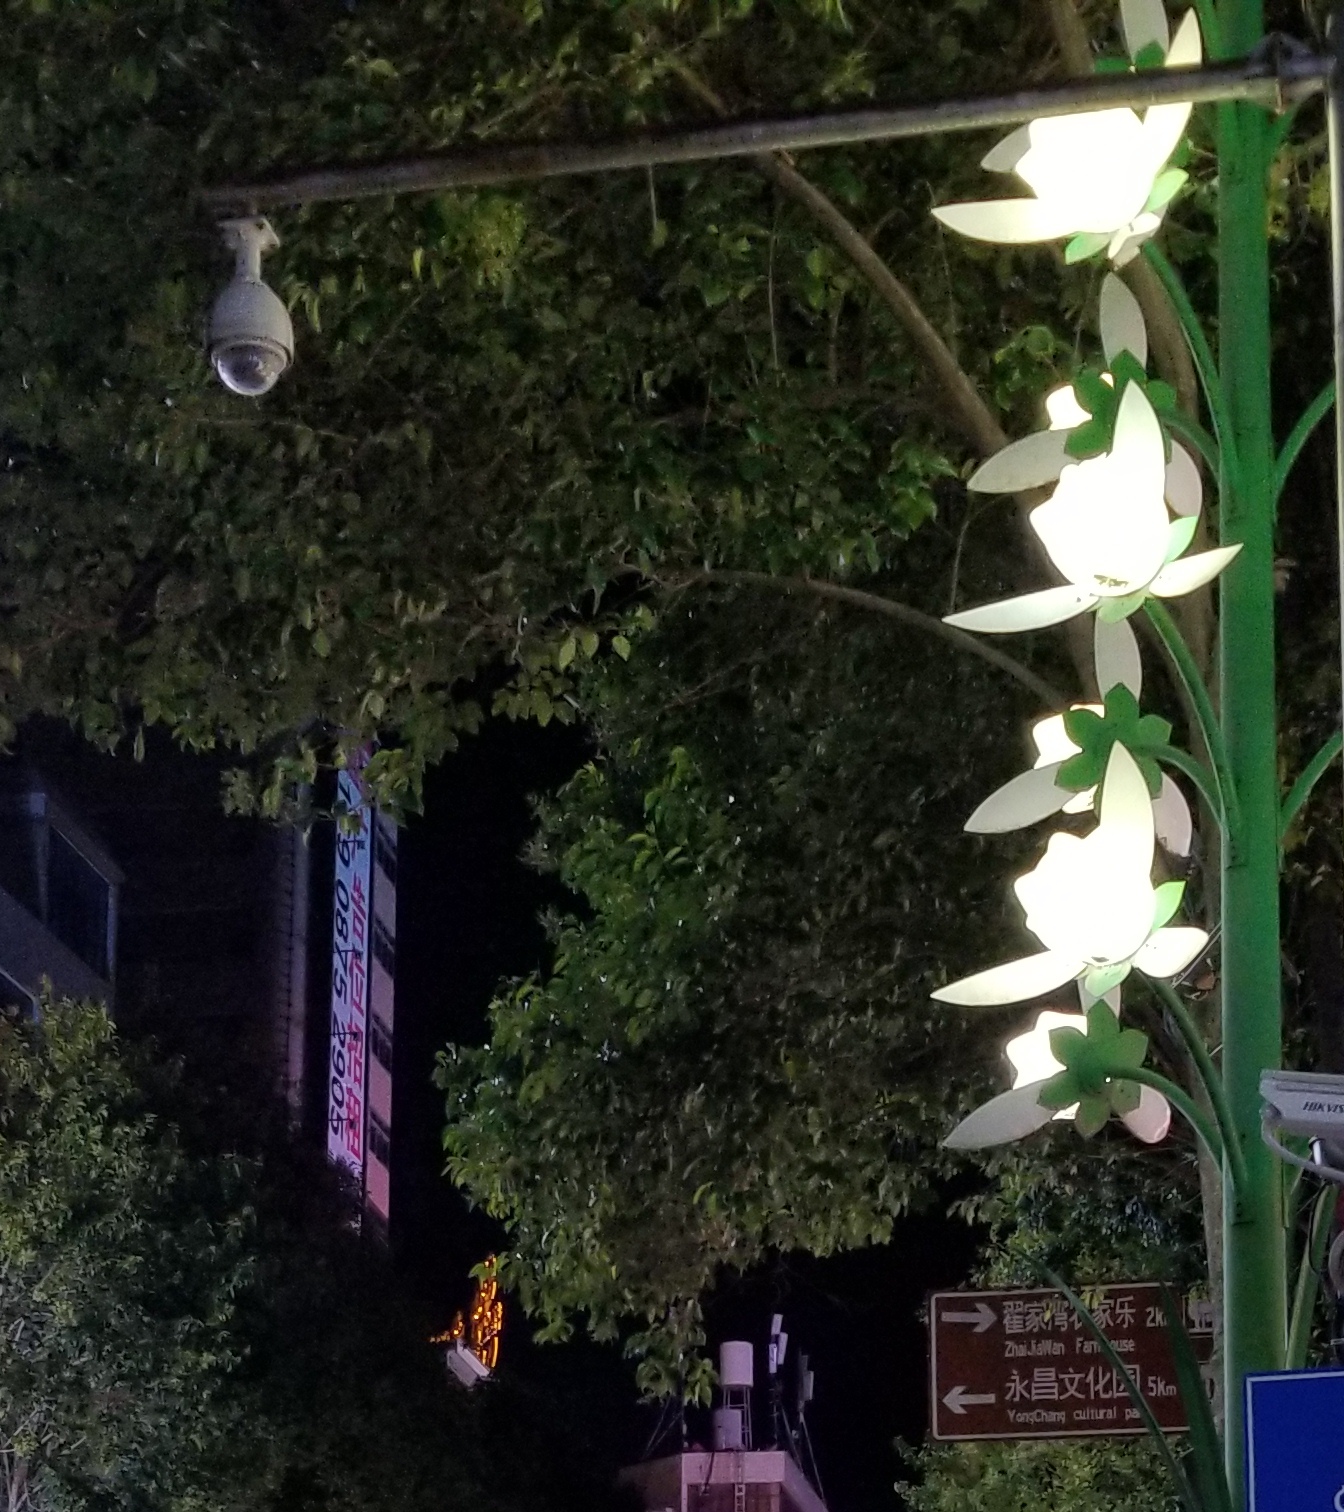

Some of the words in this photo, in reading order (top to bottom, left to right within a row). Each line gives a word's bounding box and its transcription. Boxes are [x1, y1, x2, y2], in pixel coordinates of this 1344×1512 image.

[1004, 1339, 1065, 1357] ZhaiJiaWan
[1006, 1365, 1140, 1401] 永昌文化园
[1007, 1408, 1066, 1425] YongChang
[1073, 1406, 1117, 1421] cultural
